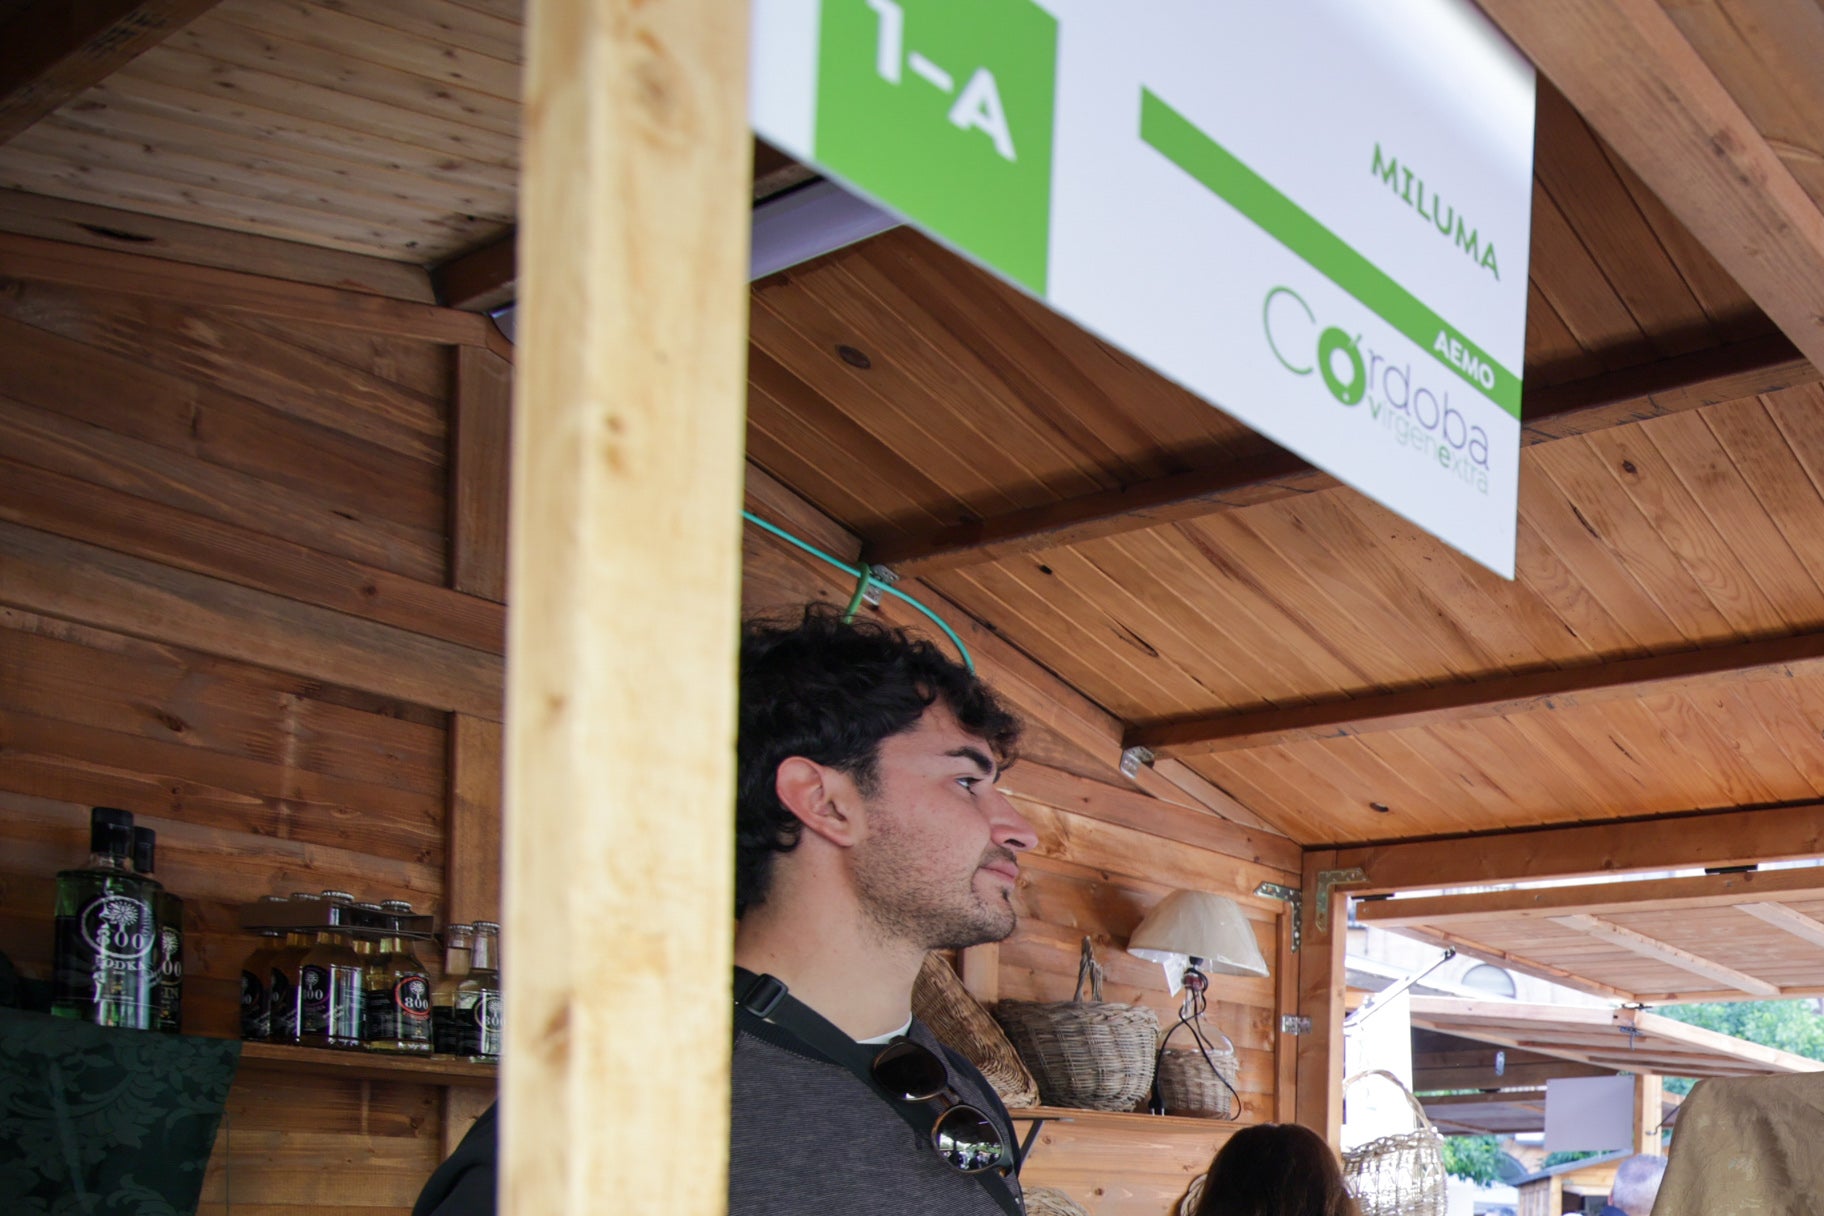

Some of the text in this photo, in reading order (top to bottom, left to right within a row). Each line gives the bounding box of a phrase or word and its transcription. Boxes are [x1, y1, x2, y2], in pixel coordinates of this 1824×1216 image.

[865, 0, 1017, 163] 1-A
[1371, 142, 1500, 282] MILUMA
[1264, 286, 1490, 471] Córdoba
[1432, 329, 1496, 390] AEMO
[1367, 395, 1489, 495] virgenextra
[162, 959, 182, 977] 00
[404, 996, 429, 1010] 800
